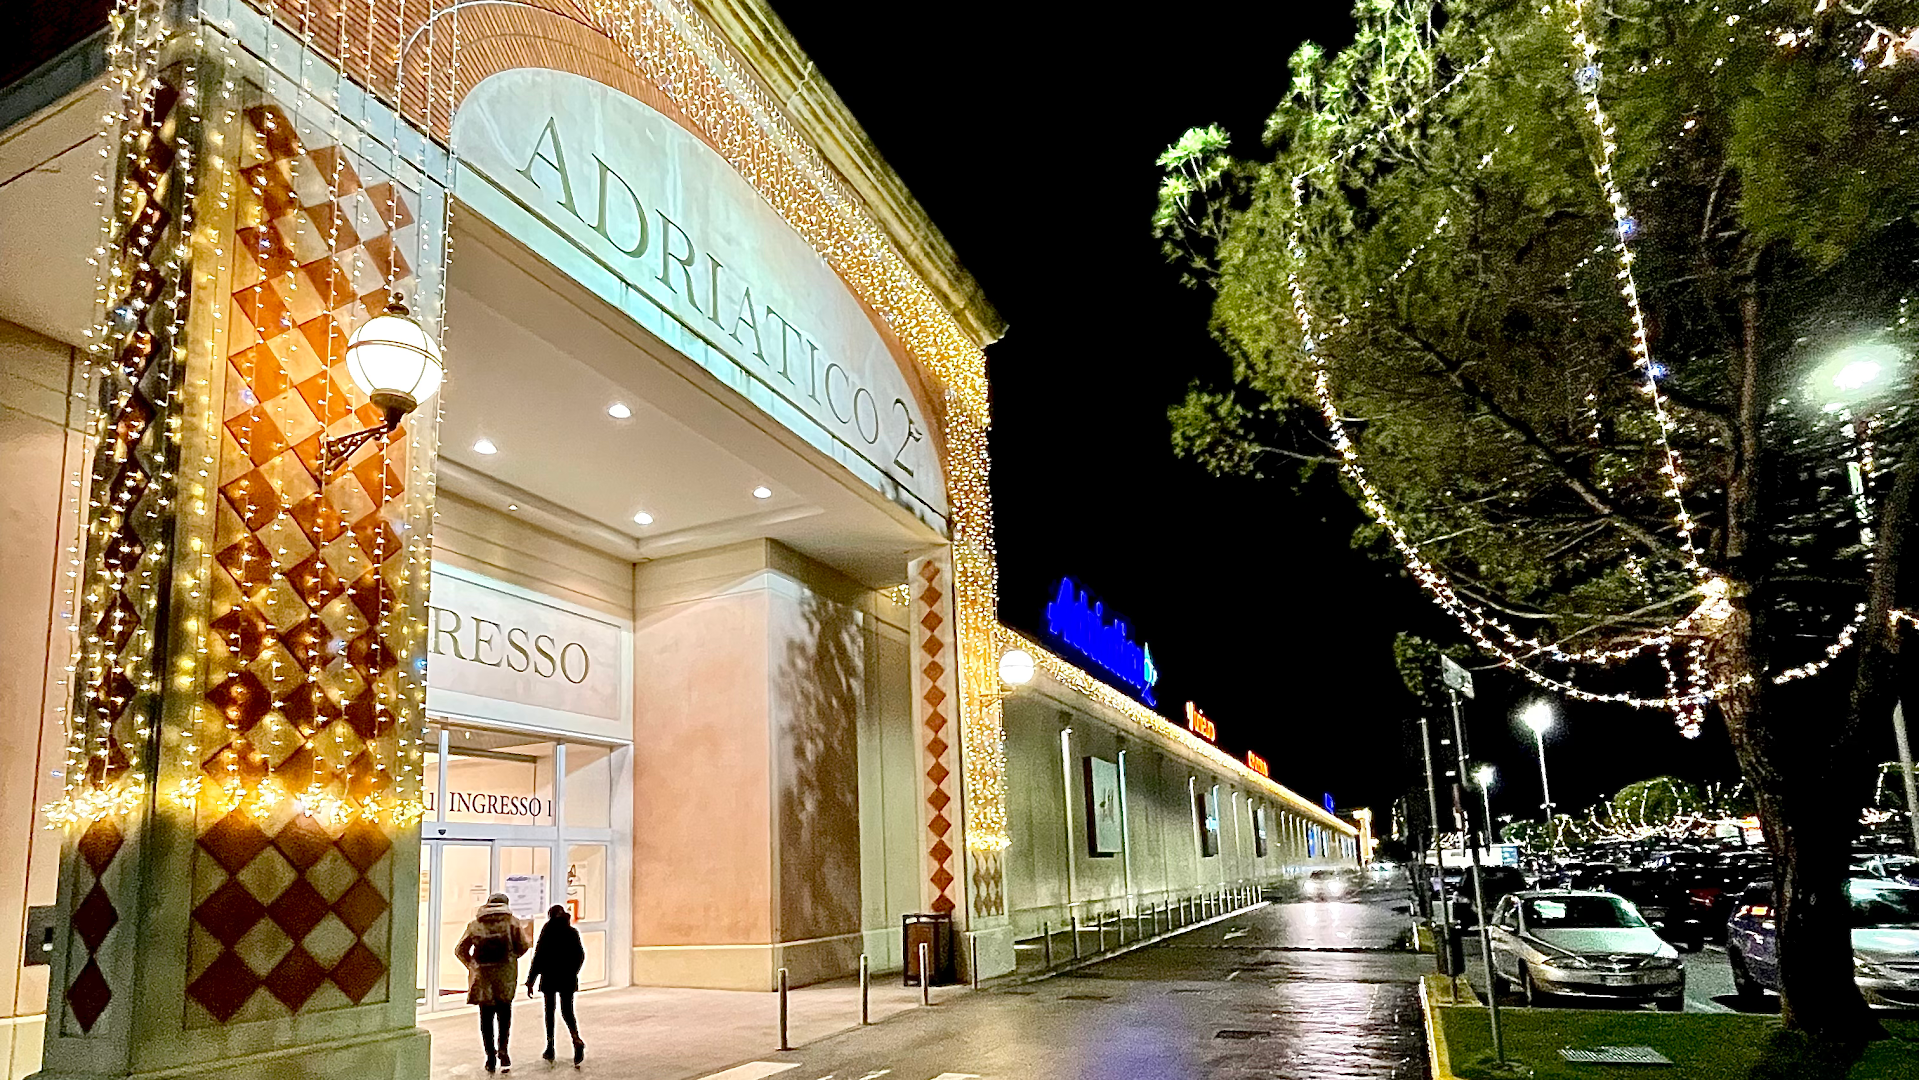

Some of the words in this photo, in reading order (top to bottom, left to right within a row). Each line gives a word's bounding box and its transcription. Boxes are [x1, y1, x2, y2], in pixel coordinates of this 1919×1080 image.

[515, 116, 879, 445] ADRIATICO
[892, 397, 923, 478] 2
[449, 791, 542, 817] INGRESSO
